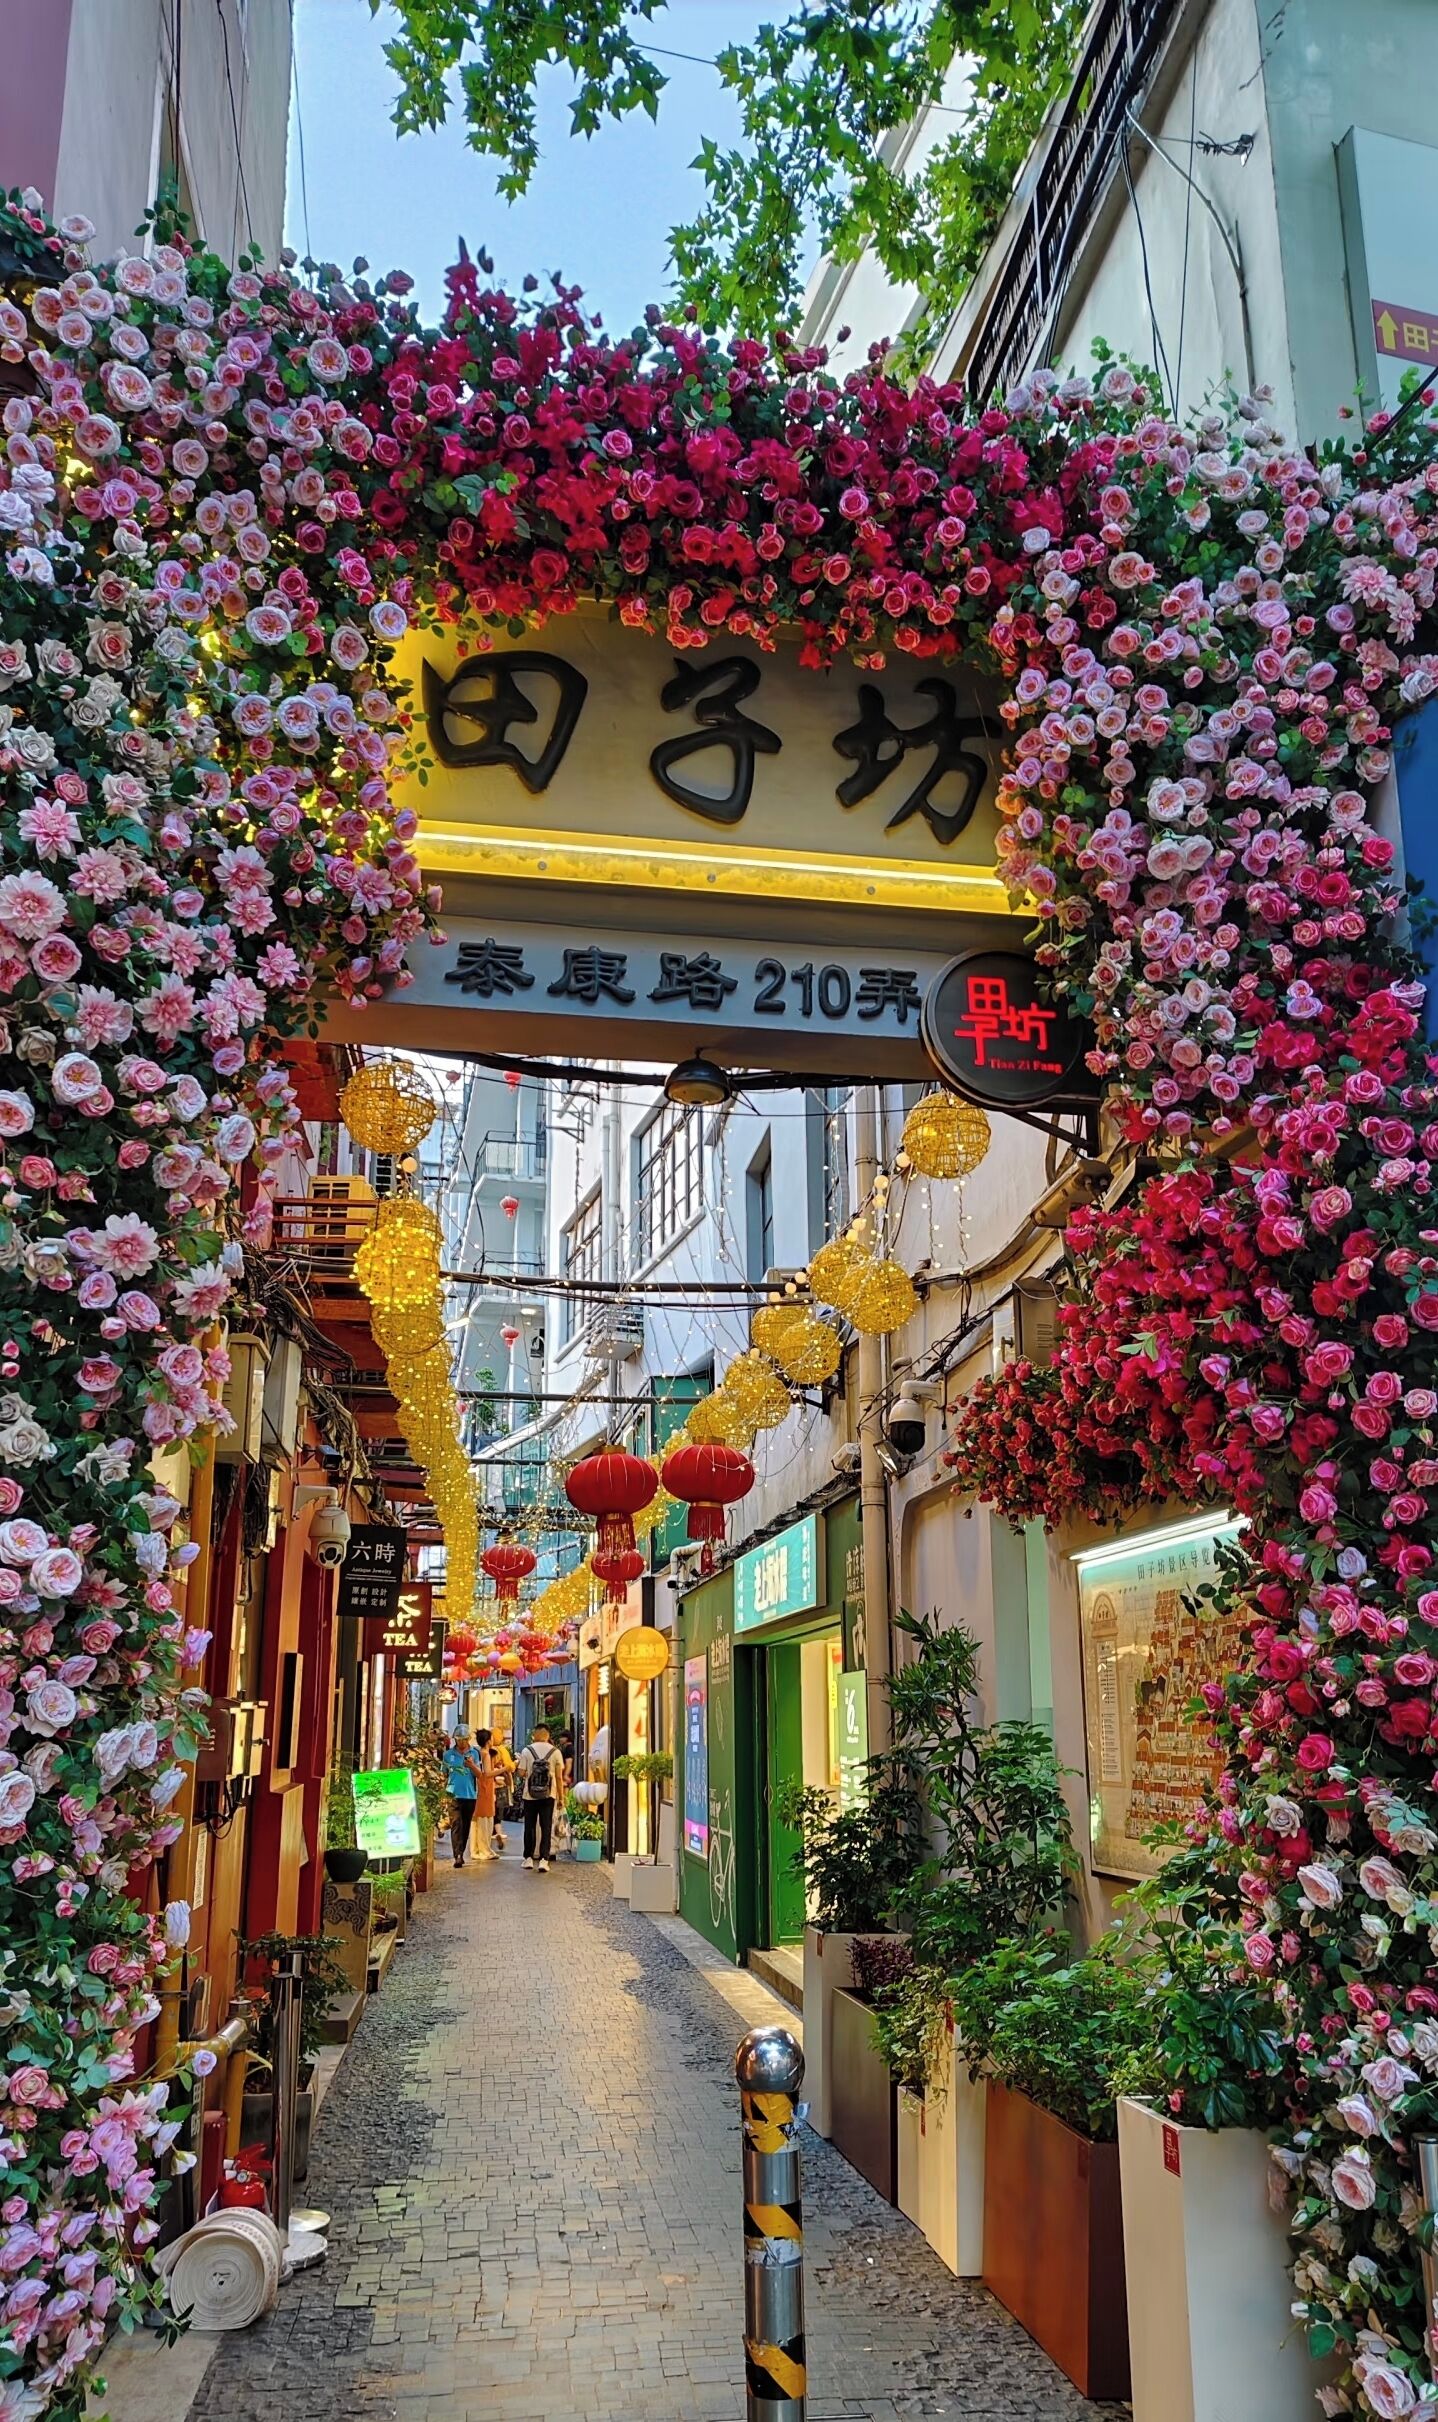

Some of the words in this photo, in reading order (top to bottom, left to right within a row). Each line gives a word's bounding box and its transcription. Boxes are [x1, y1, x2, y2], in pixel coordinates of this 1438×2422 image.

[1403, 322, 1438, 352] 田
[421, 650, 1002, 844] 田子坊
[444, 938, 921, 1023] 泰康路210弄
[990, 1057, 1015, 1070] Tian
[1017, 1059, 1030, 1071] Zi
[1033, 1060, 1063, 1075] Fang
[351, 1540, 396, 1563] 六時
[1137, 1546, 1217, 1580] 田子坊景区导览
[351, 1566, 371, 1574] Antique
[372, 1567, 392, 1575] Jewelry
[382, 1633, 418, 1647] TEA
[405, 1661, 433, 1672] TEA
